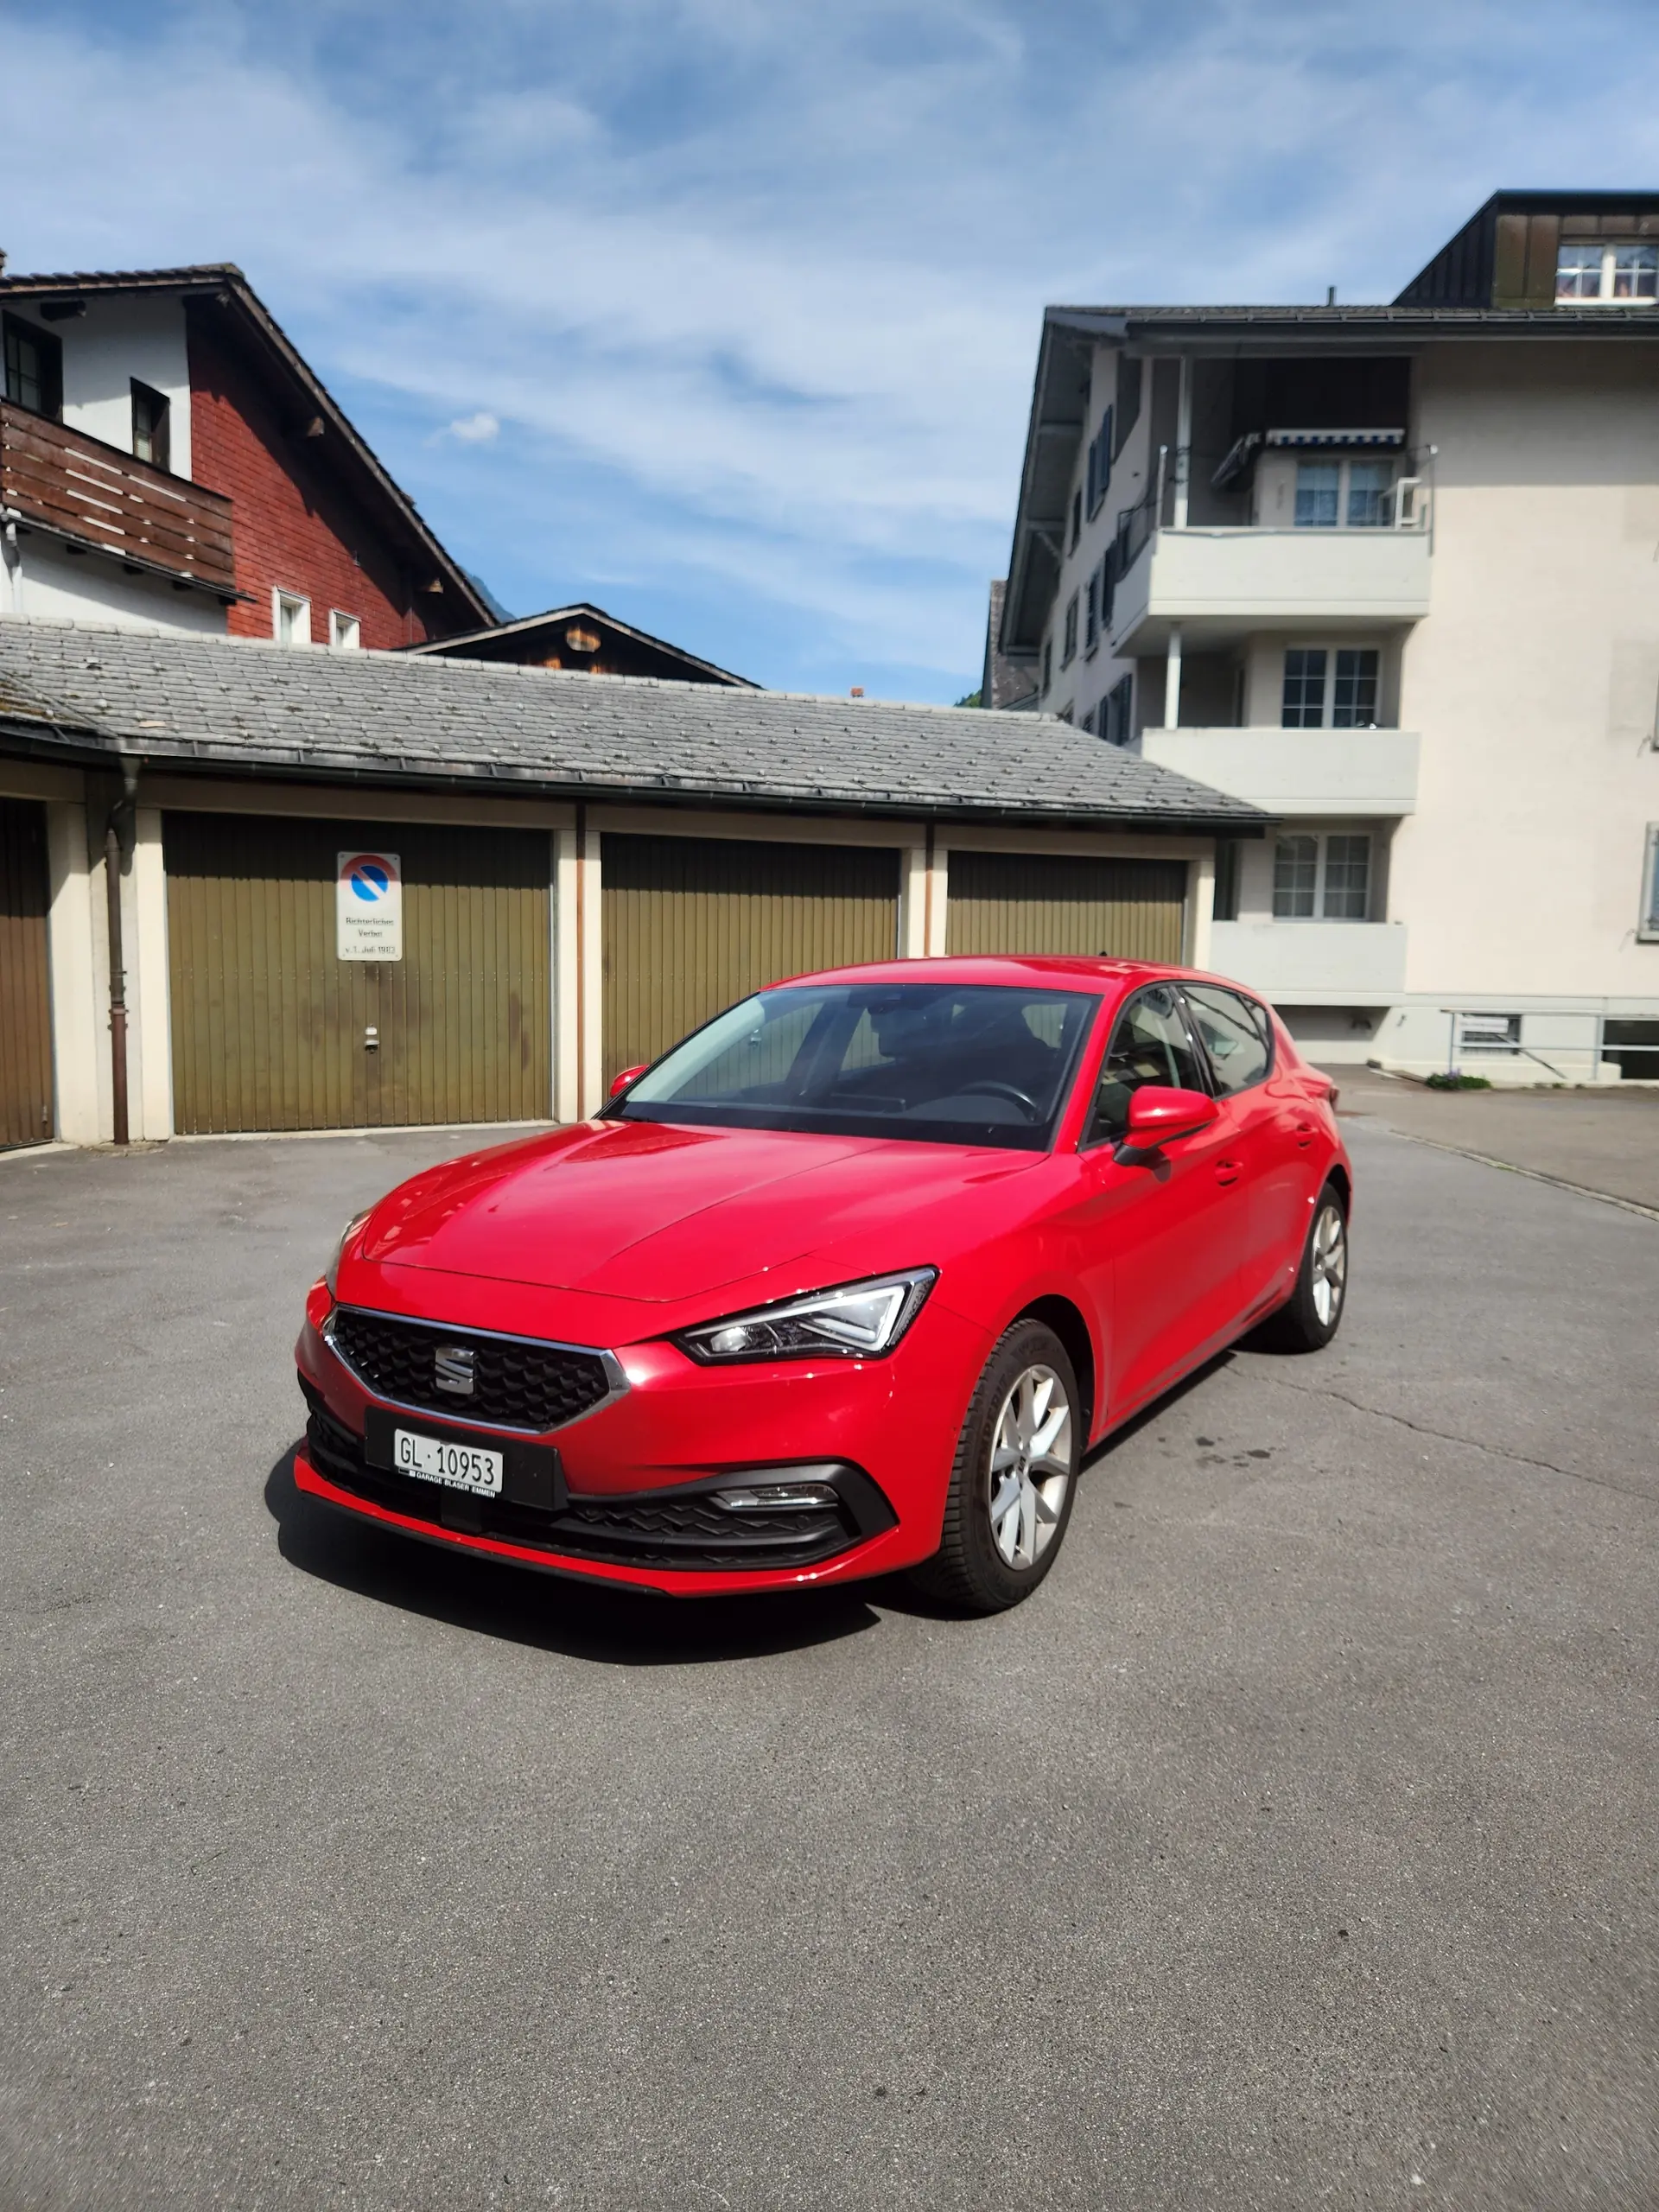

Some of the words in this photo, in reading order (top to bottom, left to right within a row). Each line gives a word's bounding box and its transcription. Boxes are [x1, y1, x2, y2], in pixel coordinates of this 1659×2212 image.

[346, 917, 394, 925] Richterliches
[361, 945, 376, 954] Juli
[437, 1446, 495, 1485] 10953
[416, 1471, 442, 1484] GARAGE
[444, 1478, 470, 1491] BLASER
[472, 1485, 496, 1498] EMMEN
